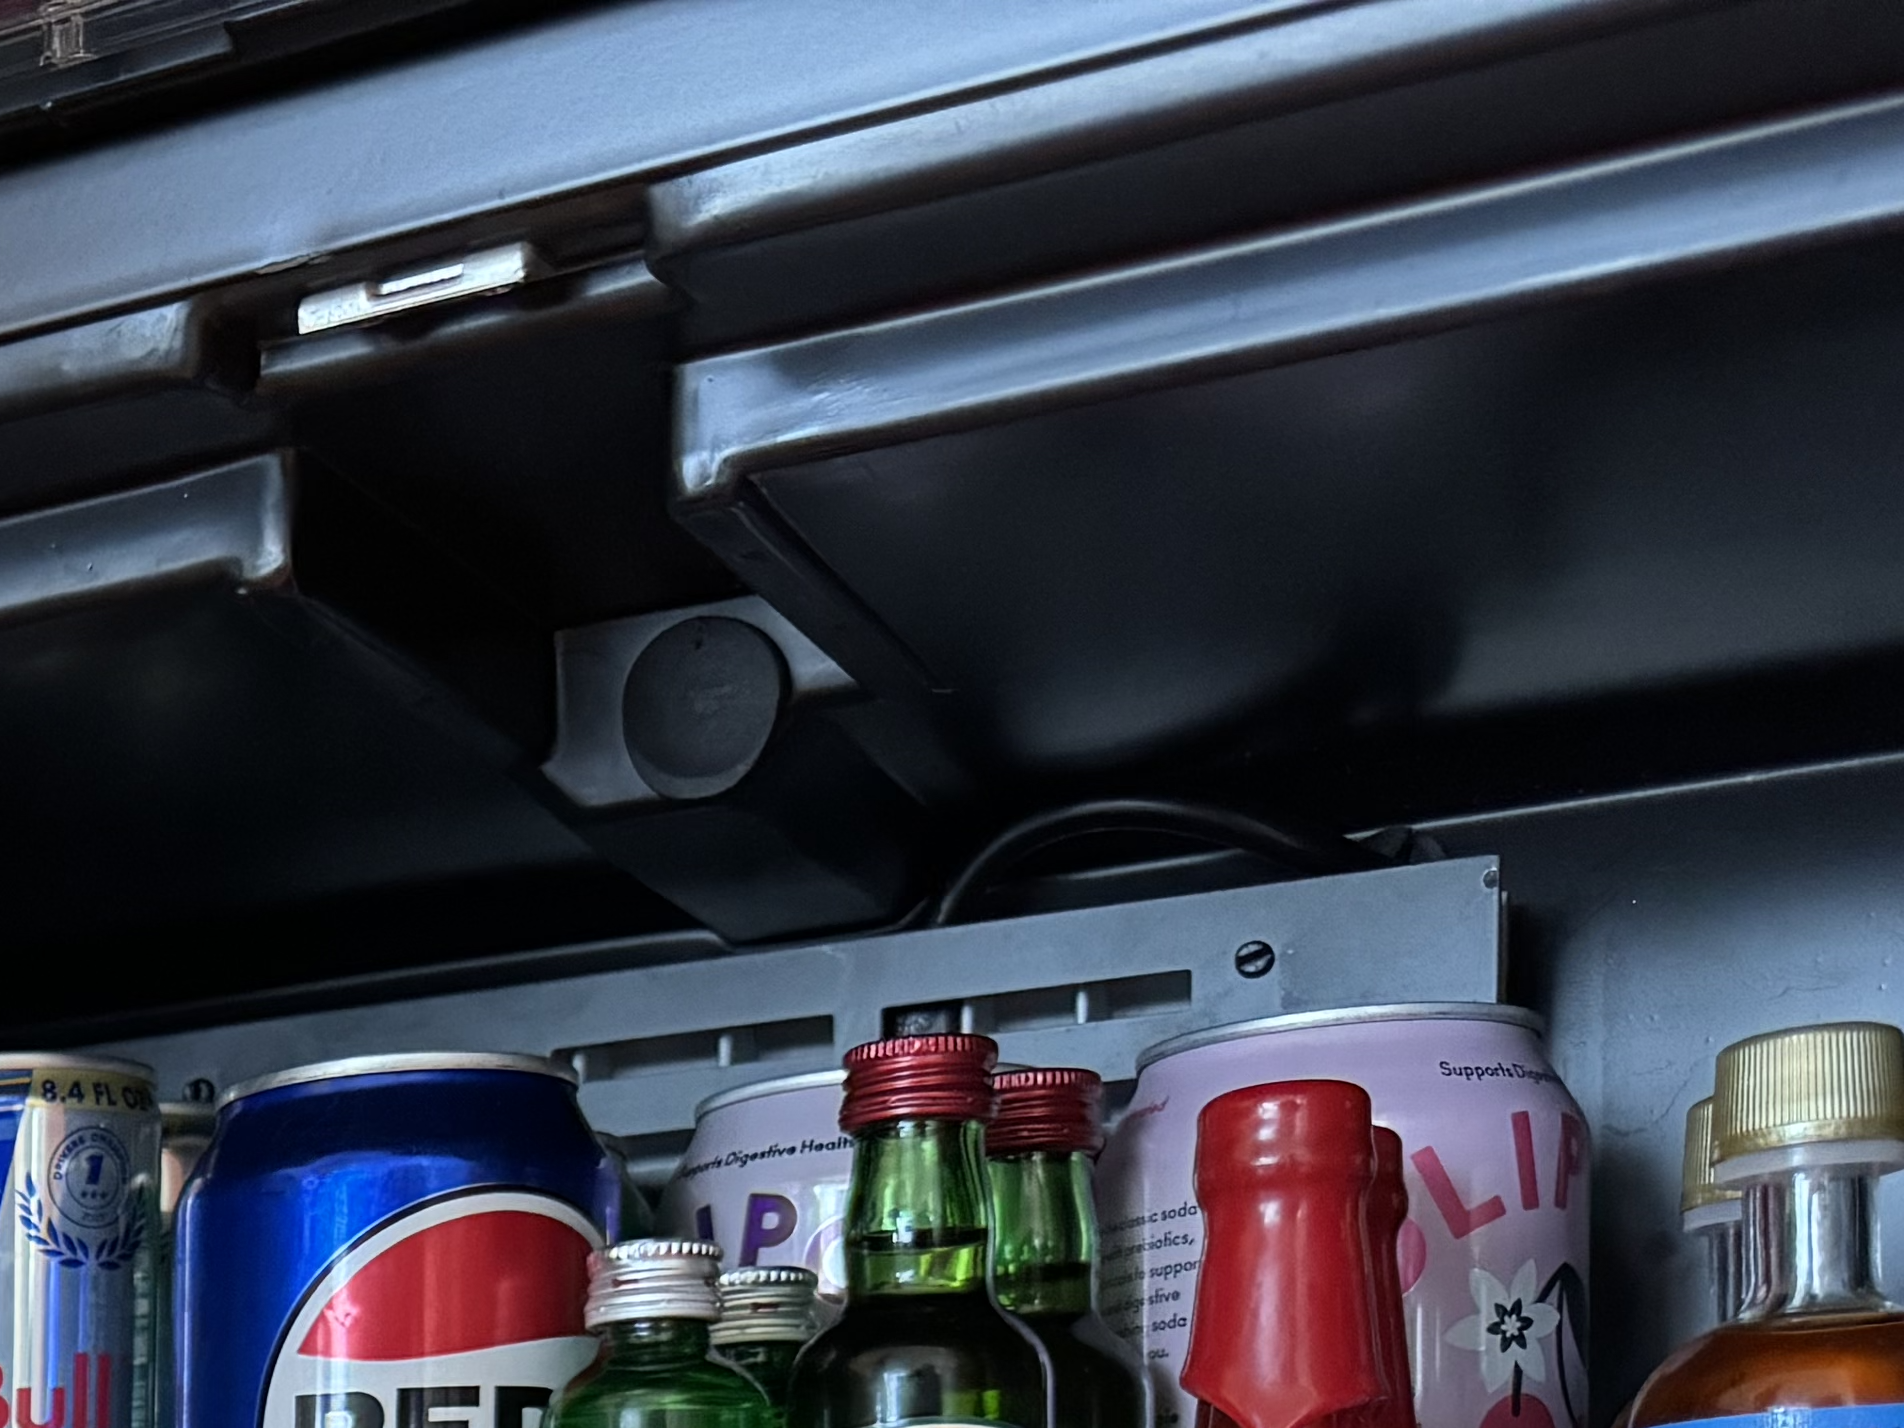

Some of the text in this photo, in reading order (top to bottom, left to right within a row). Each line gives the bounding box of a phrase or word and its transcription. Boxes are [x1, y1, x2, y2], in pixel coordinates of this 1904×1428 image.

[41, 1079, 117, 1106] 8.4 FL
[724, 1143, 796, 1168] Digestive
[1160, 1201, 1199, 1223] soda
